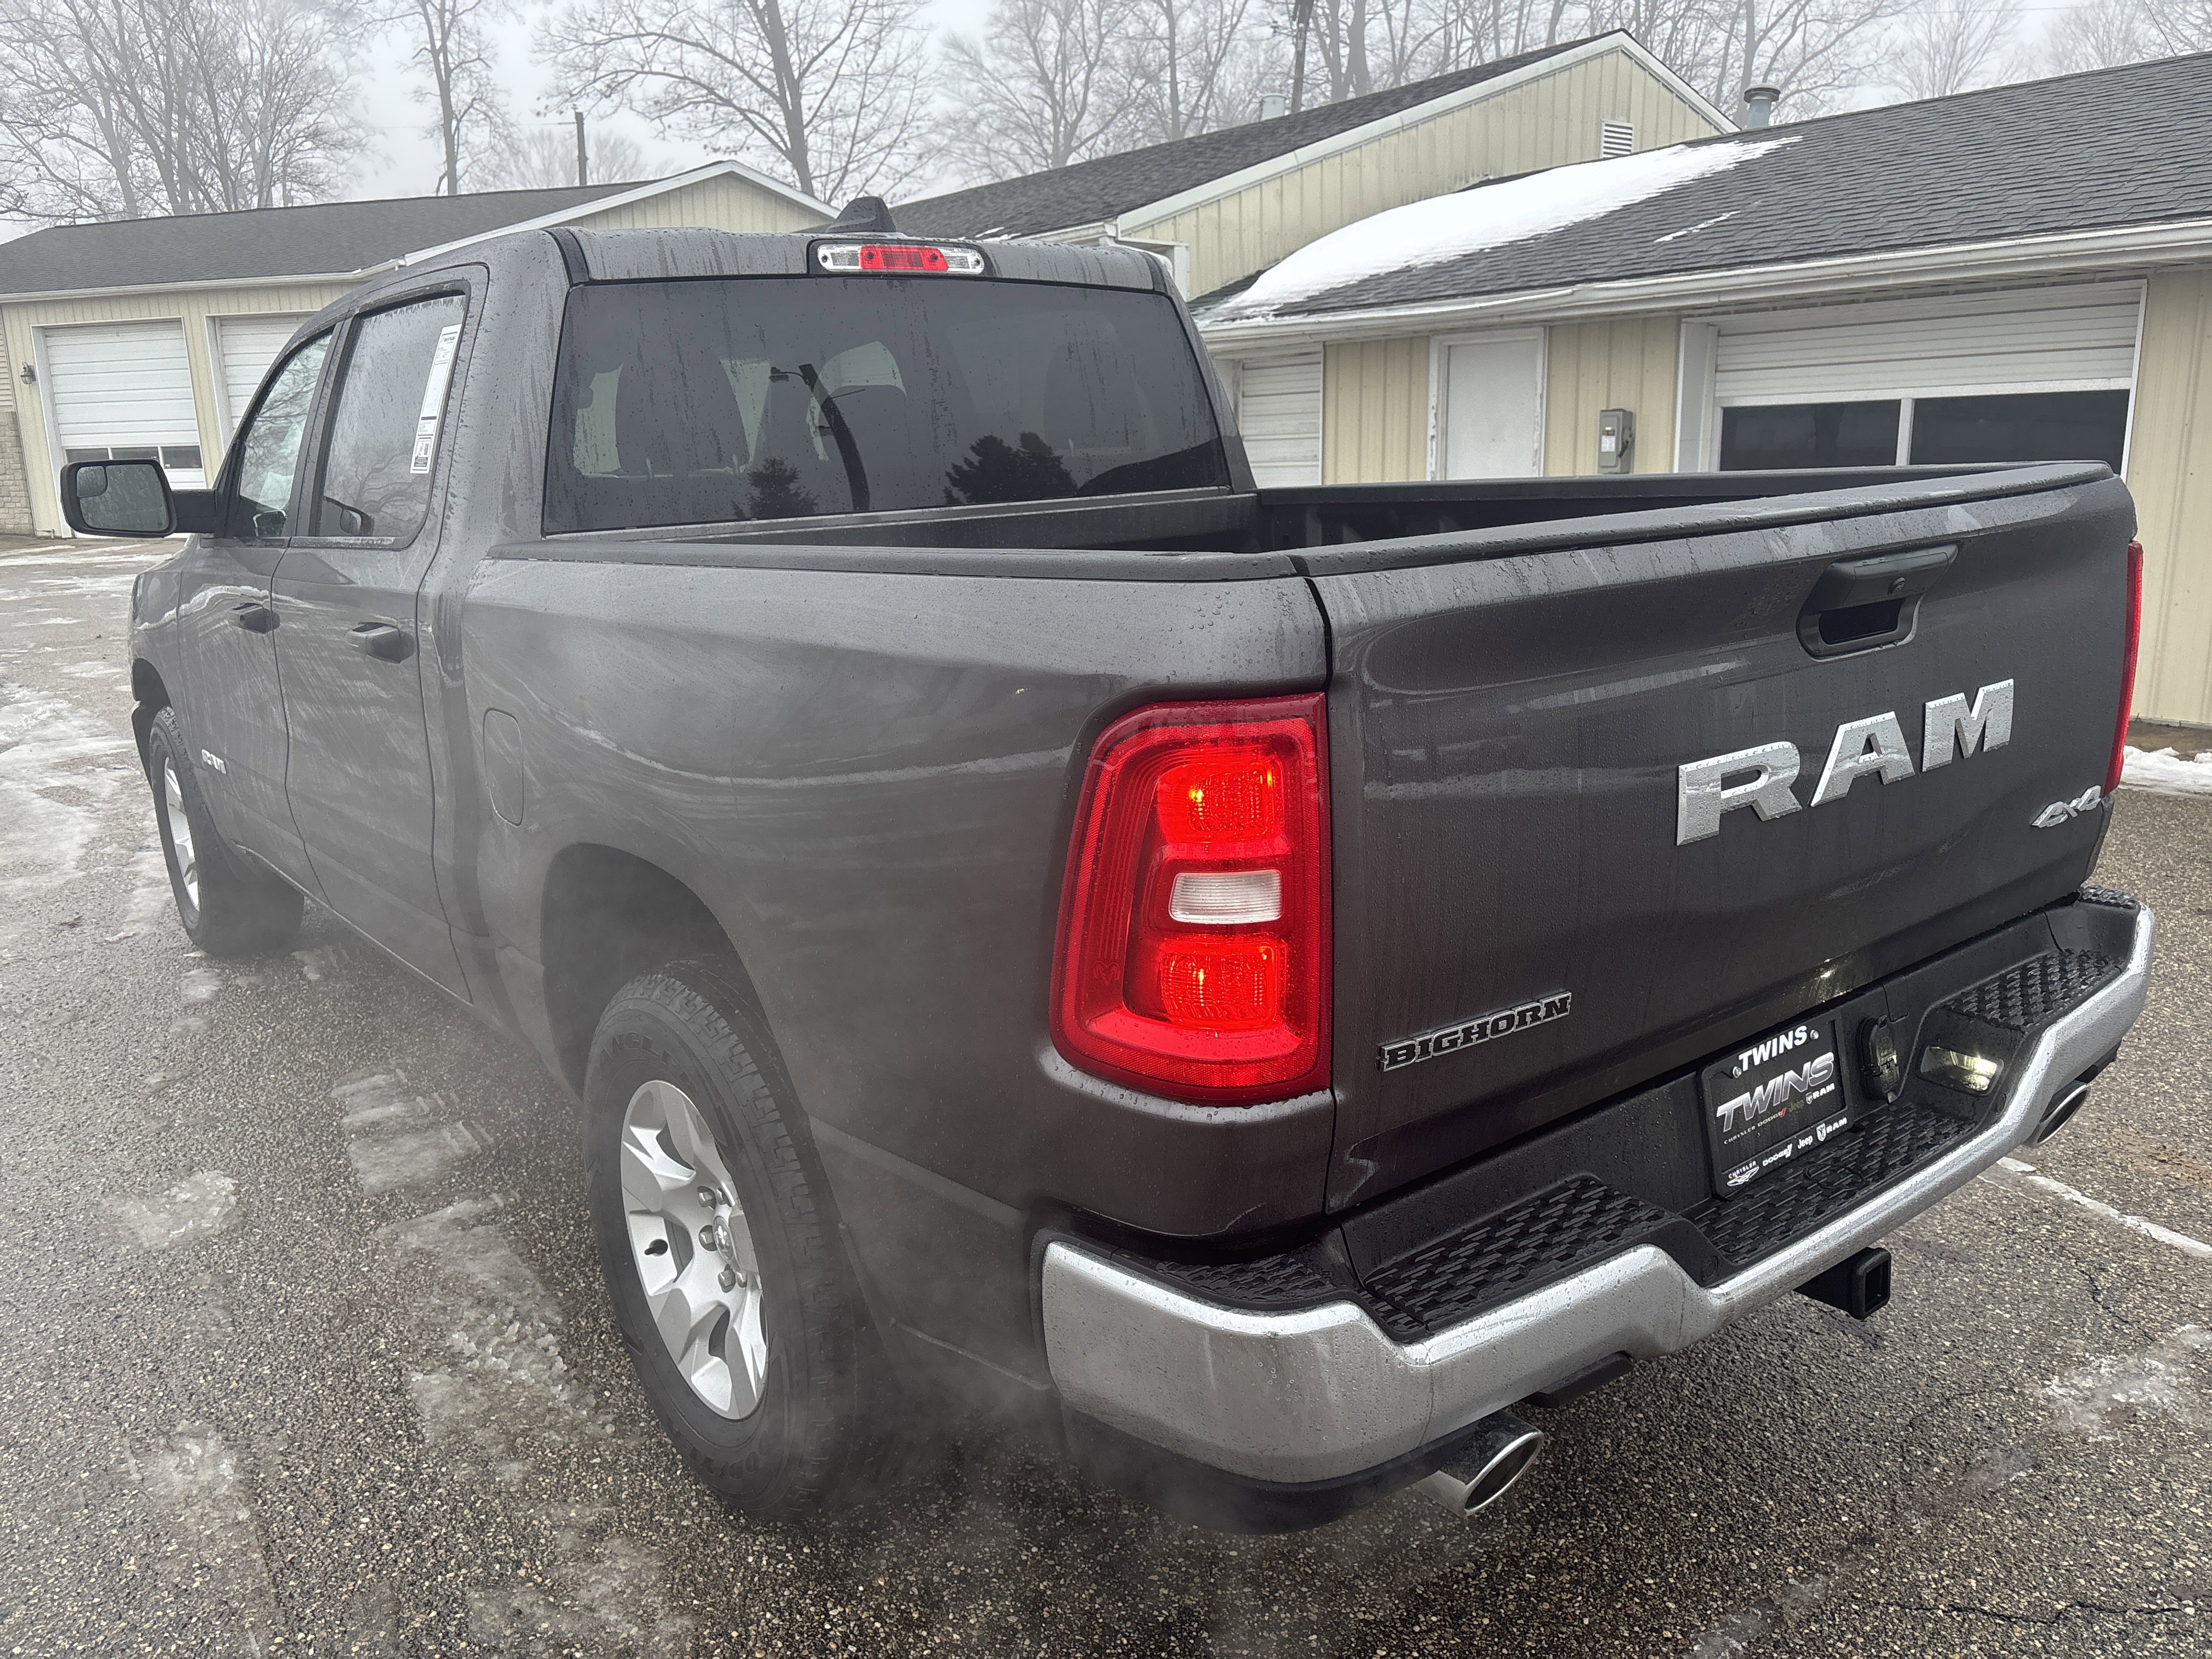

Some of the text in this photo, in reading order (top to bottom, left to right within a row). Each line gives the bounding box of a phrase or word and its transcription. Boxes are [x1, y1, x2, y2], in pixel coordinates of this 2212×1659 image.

[1677, 678, 2015, 846] RAM
[1379, 990, 1572, 1072] BIGHORN
[1739, 1025, 1807, 1072] TWINS
[1716, 1052, 1834, 1133] TWINS
[1789, 1099, 1804, 1113] Jeep
[1813, 1082, 1835, 1099] RAM
[1729, 1117, 1847, 1179] CHRYSLER DODGE Jeep RAM
